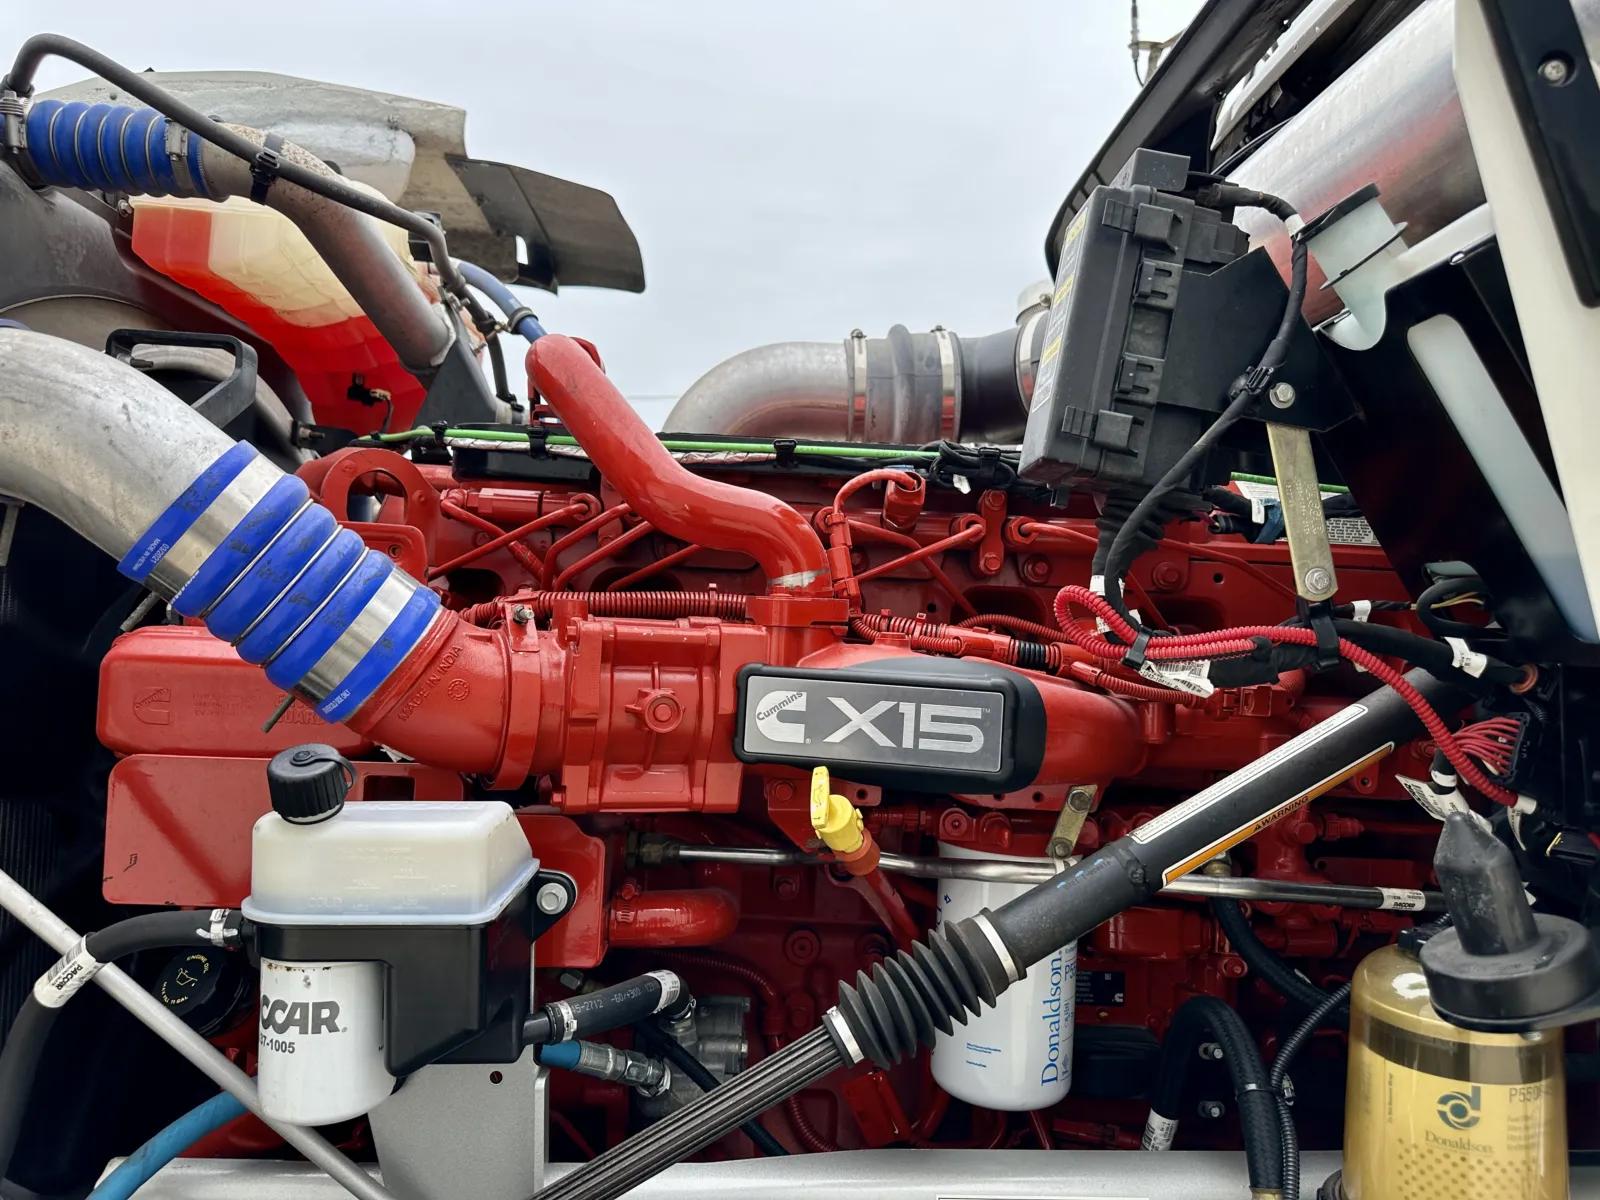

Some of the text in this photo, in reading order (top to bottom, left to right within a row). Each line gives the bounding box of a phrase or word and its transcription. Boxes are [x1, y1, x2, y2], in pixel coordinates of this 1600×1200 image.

[398, 645, 463, 721] MADE IN INDIA
[756, 690, 803, 721] Cummins
[823, 697, 984, 753] X15
[1259, 795, 1309, 829] WARNING
[55, 964, 84, 992] PACCAR
[1041, 956, 1062, 1086] Donaldson
[1425, 1130, 1493, 1152] Donaldson
